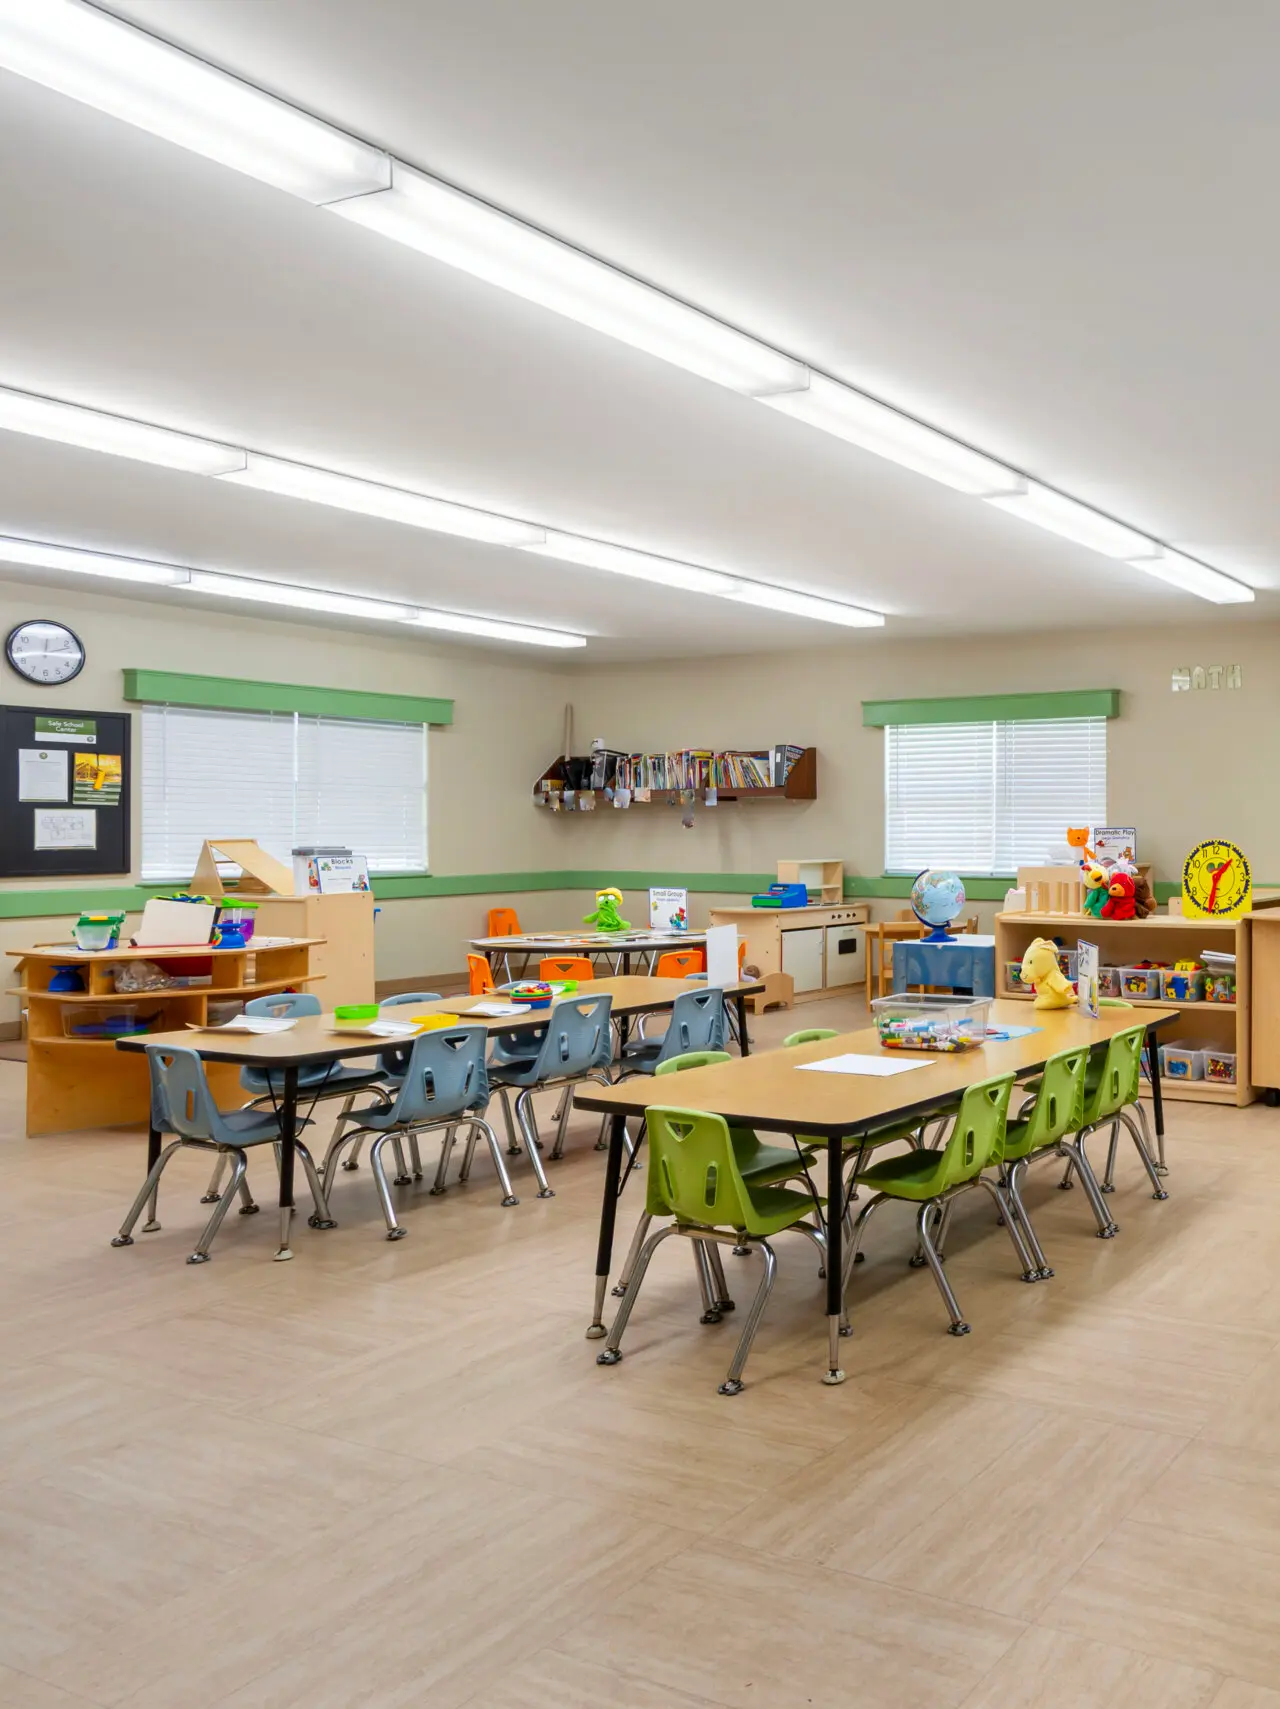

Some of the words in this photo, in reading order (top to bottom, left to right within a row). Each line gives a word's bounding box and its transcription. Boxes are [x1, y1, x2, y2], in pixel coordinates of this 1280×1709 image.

[20, 636, 29, 644] 10
[63, 640, 70, 648] 2
[31, 665, 36, 673] 7
[42, 669, 49, 677] 6
[55, 667, 61, 675] 5
[1171, 664, 1242, 692] MATH
[48, 720, 62, 728] Safe
[63, 721, 84, 729] School
[1202, 849, 1208, 858] 11
[1212, 846, 1220, 855] 12
[1192, 859, 1201, 869] 10
[1235, 859, 1241, 869] 2
[1187, 873, 1194, 882] 9
[1240, 872, 1245, 882] 3
[1191, 887, 1197, 896] 8
[1235, 887, 1241, 895] 4
[1202, 897, 1208, 906] 7
[1213, 901, 1220, 909] 6
[1226, 896, 1233, 906] 5
